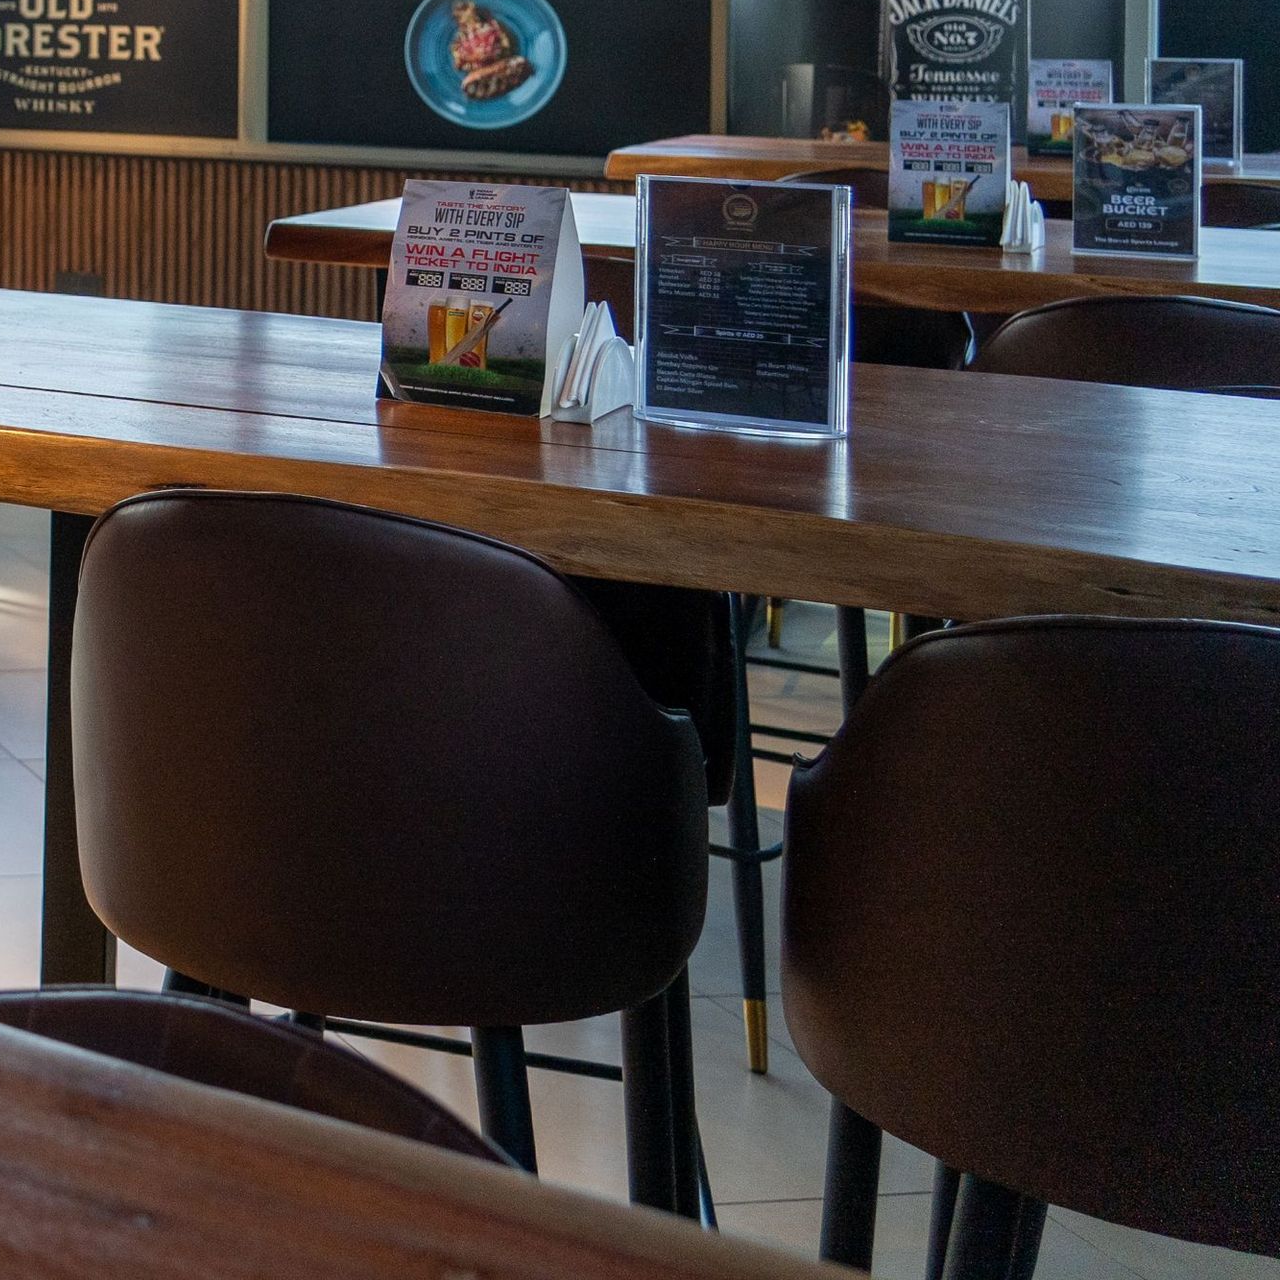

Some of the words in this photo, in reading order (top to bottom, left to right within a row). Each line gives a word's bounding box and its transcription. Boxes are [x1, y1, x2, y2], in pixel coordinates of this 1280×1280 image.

[933, 30, 977, 46] No.7
[24, 65, 88, 77] KENTUCKY
[909, 63, 1000, 84] Tennessee
[57, 72, 122, 95] BOURBON
[14, 97, 95, 115] WHISKY
[917, 118, 938, 129] WITH
[940, 119, 965, 131] EVERY
[900, 142, 929, 151] WIN
[934, 143, 944, 151] A
[948, 144, 996, 153] FLIGHT
[946, 152, 961, 160] TO
[964, 152, 996, 160] INDIA
[436, 200, 465, 208] TASTE
[1110, 194, 1155, 206] BEER
[1102, 203, 1168, 216] BUCKET
[434, 207, 465, 225] WITH
[466, 209, 504, 227] EVERY
[504, 212, 525, 229] SIP
[407, 225, 444, 236] BUY
[449, 228, 460, 237] 2
[464, 229, 516, 242] PINTS
[520, 234, 545, 244] OF
[702, 240, 728, 248] HAPPY
[751, 243, 774, 251] MENU
[405, 243, 445, 257] WIN
[451, 247, 465, 258] A
[472, 249, 540, 264] FLIGHT
[404, 255, 461, 269] TICKET
[465, 260, 488, 273] TO
[493, 263, 537, 276] INDIA
